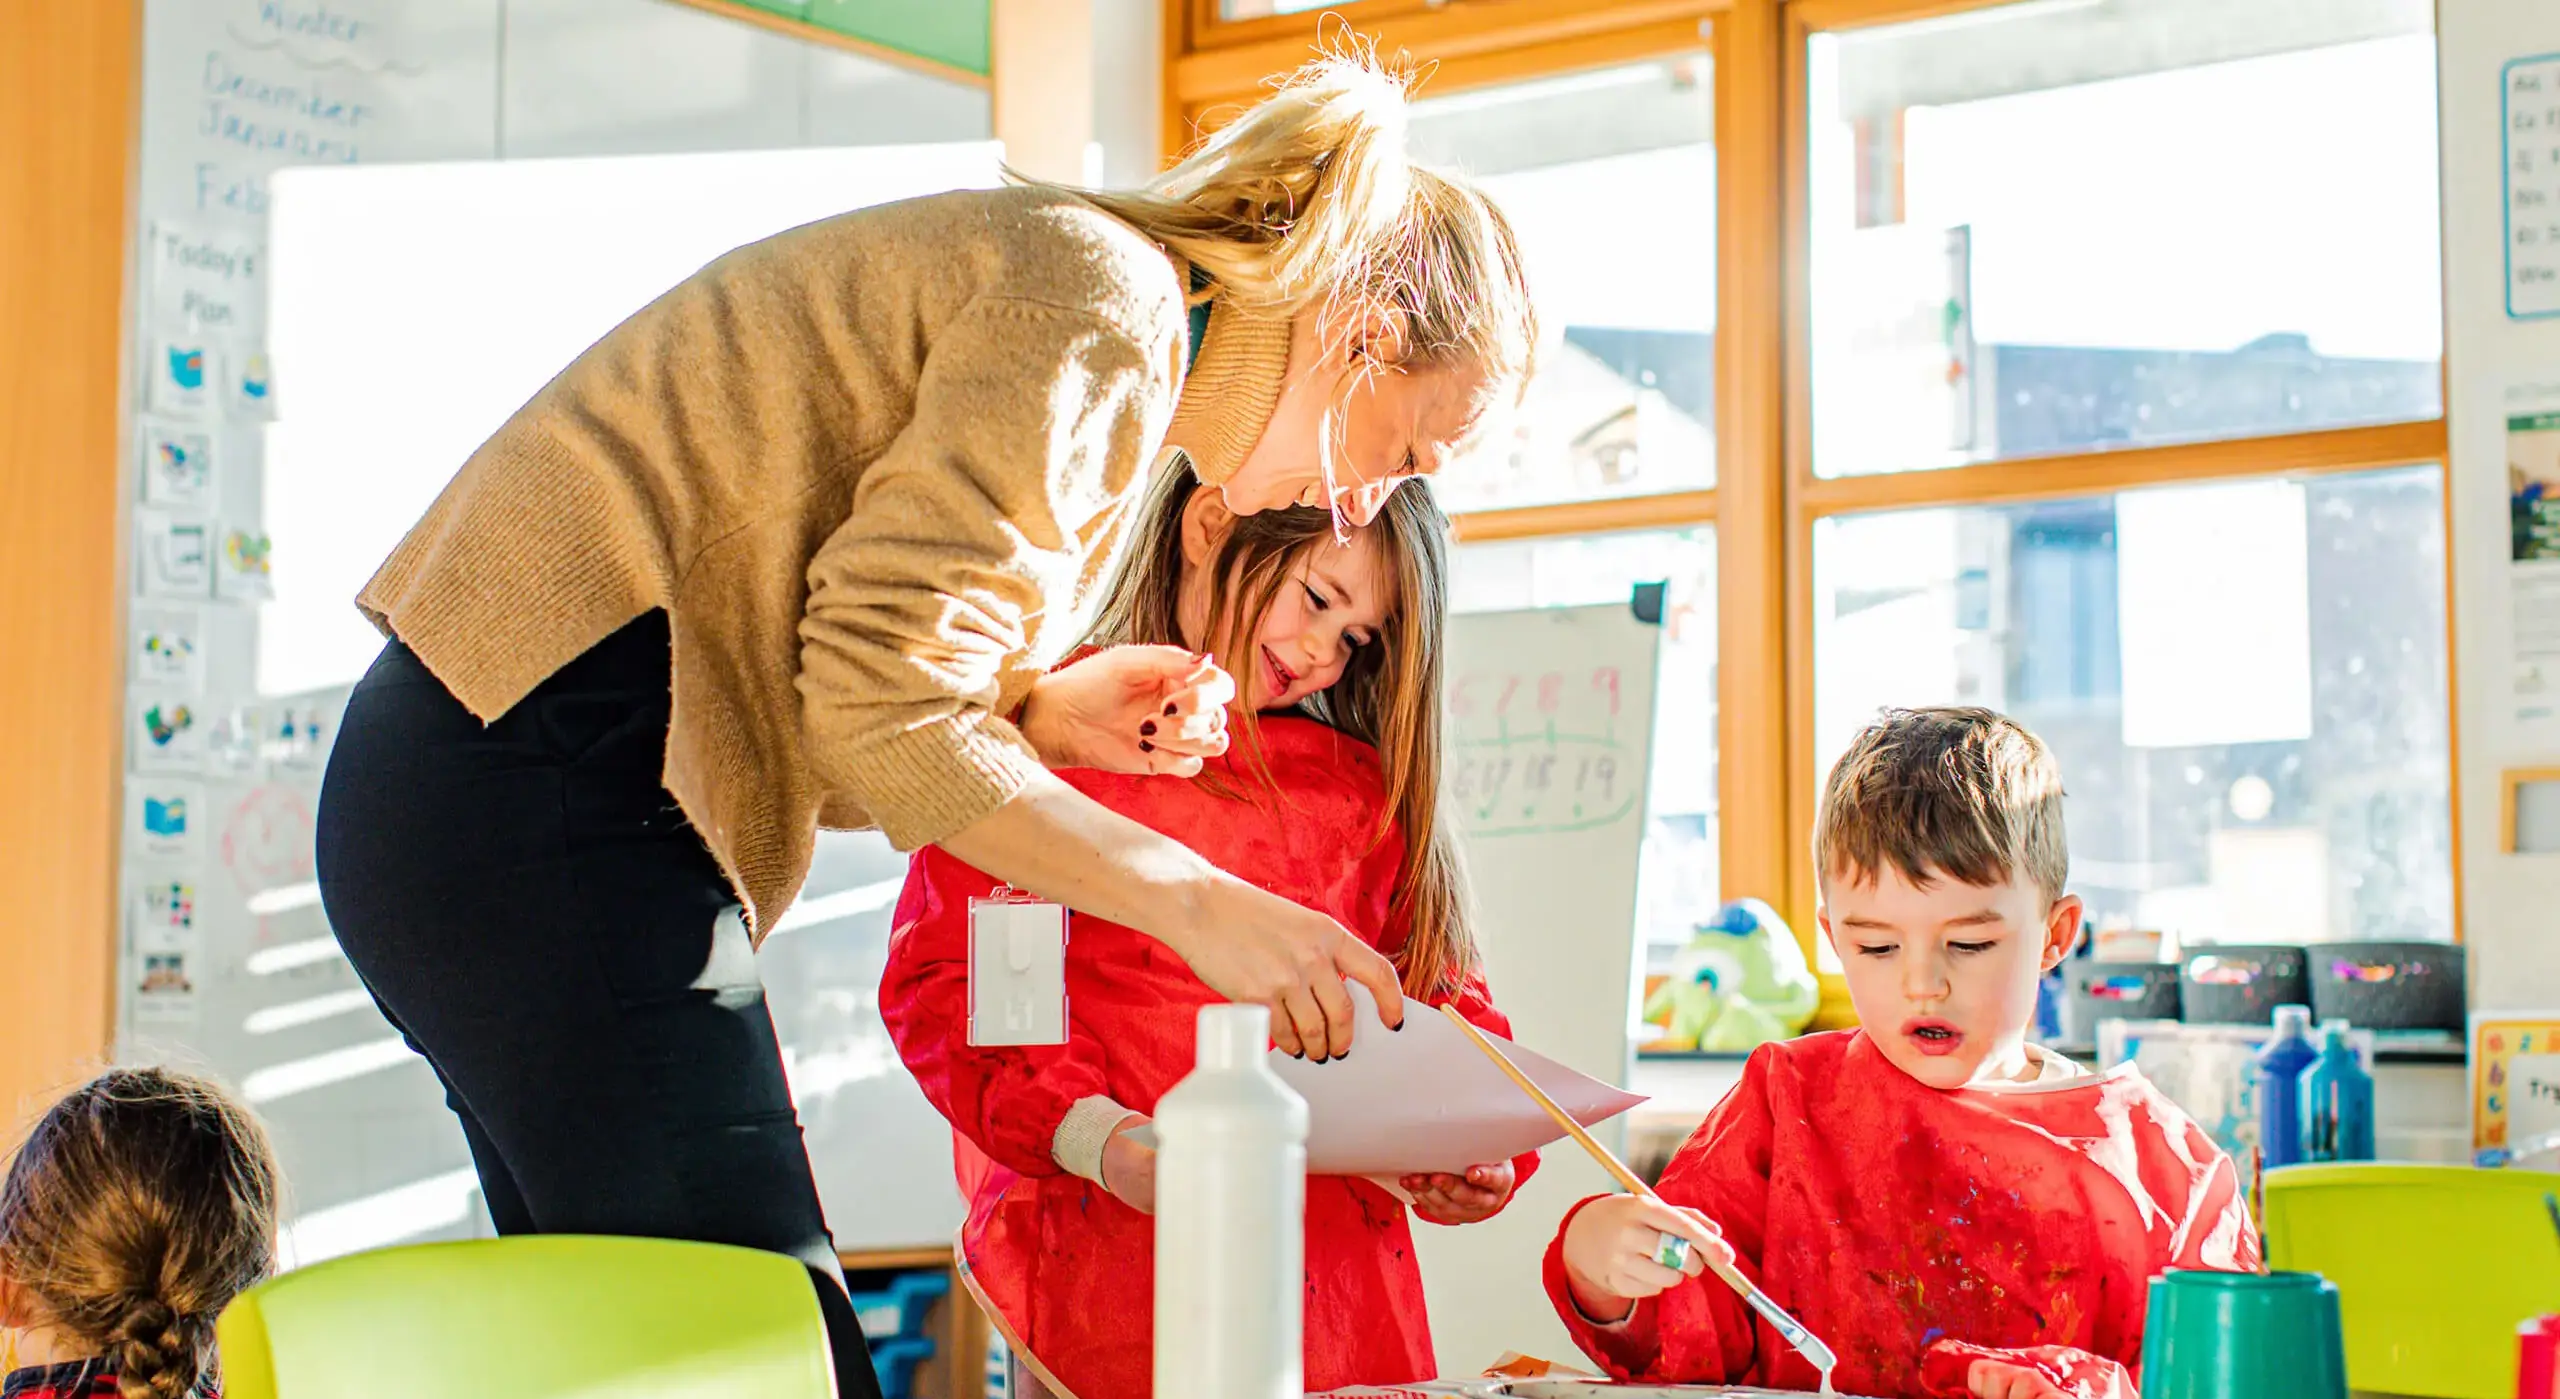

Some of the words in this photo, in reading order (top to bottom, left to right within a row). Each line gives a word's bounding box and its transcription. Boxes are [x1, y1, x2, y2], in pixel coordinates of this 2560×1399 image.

[204, 50, 368, 128] December
[1592, 666, 1620, 717] 9
[1574, 755, 1616, 801] 19
